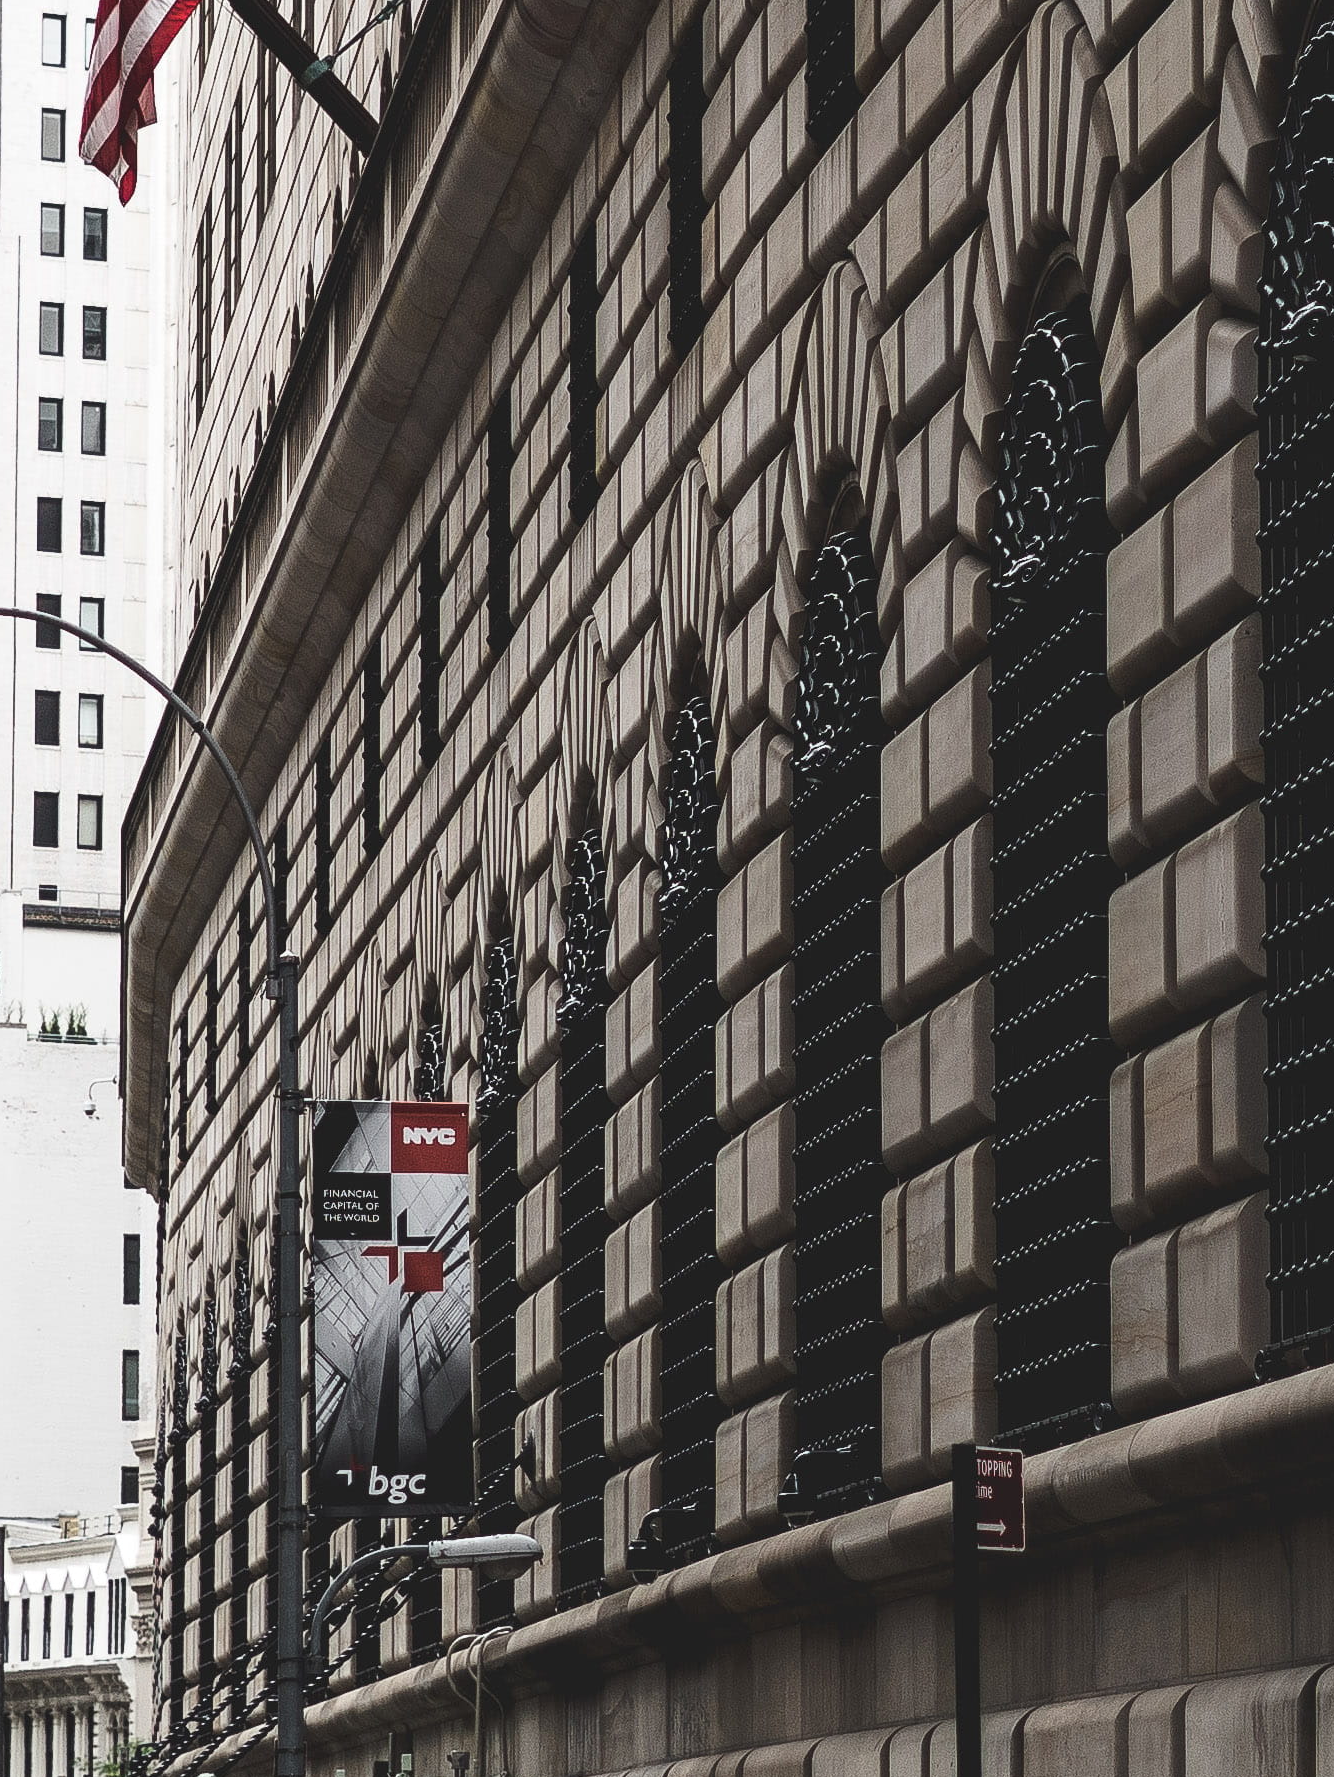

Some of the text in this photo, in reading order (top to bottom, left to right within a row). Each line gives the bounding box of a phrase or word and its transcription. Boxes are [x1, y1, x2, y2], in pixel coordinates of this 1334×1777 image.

[403, 1127, 456, 1145] NYC
[323, 1189, 379, 1199] FINANCIAL
[323, 1201, 380, 1211] CAPITAL OF
[323, 1213, 380, 1223] THE WORLD
[976, 1458, 1013, 1478] TOPPING
[368, 1465, 427, 1505] bgc
